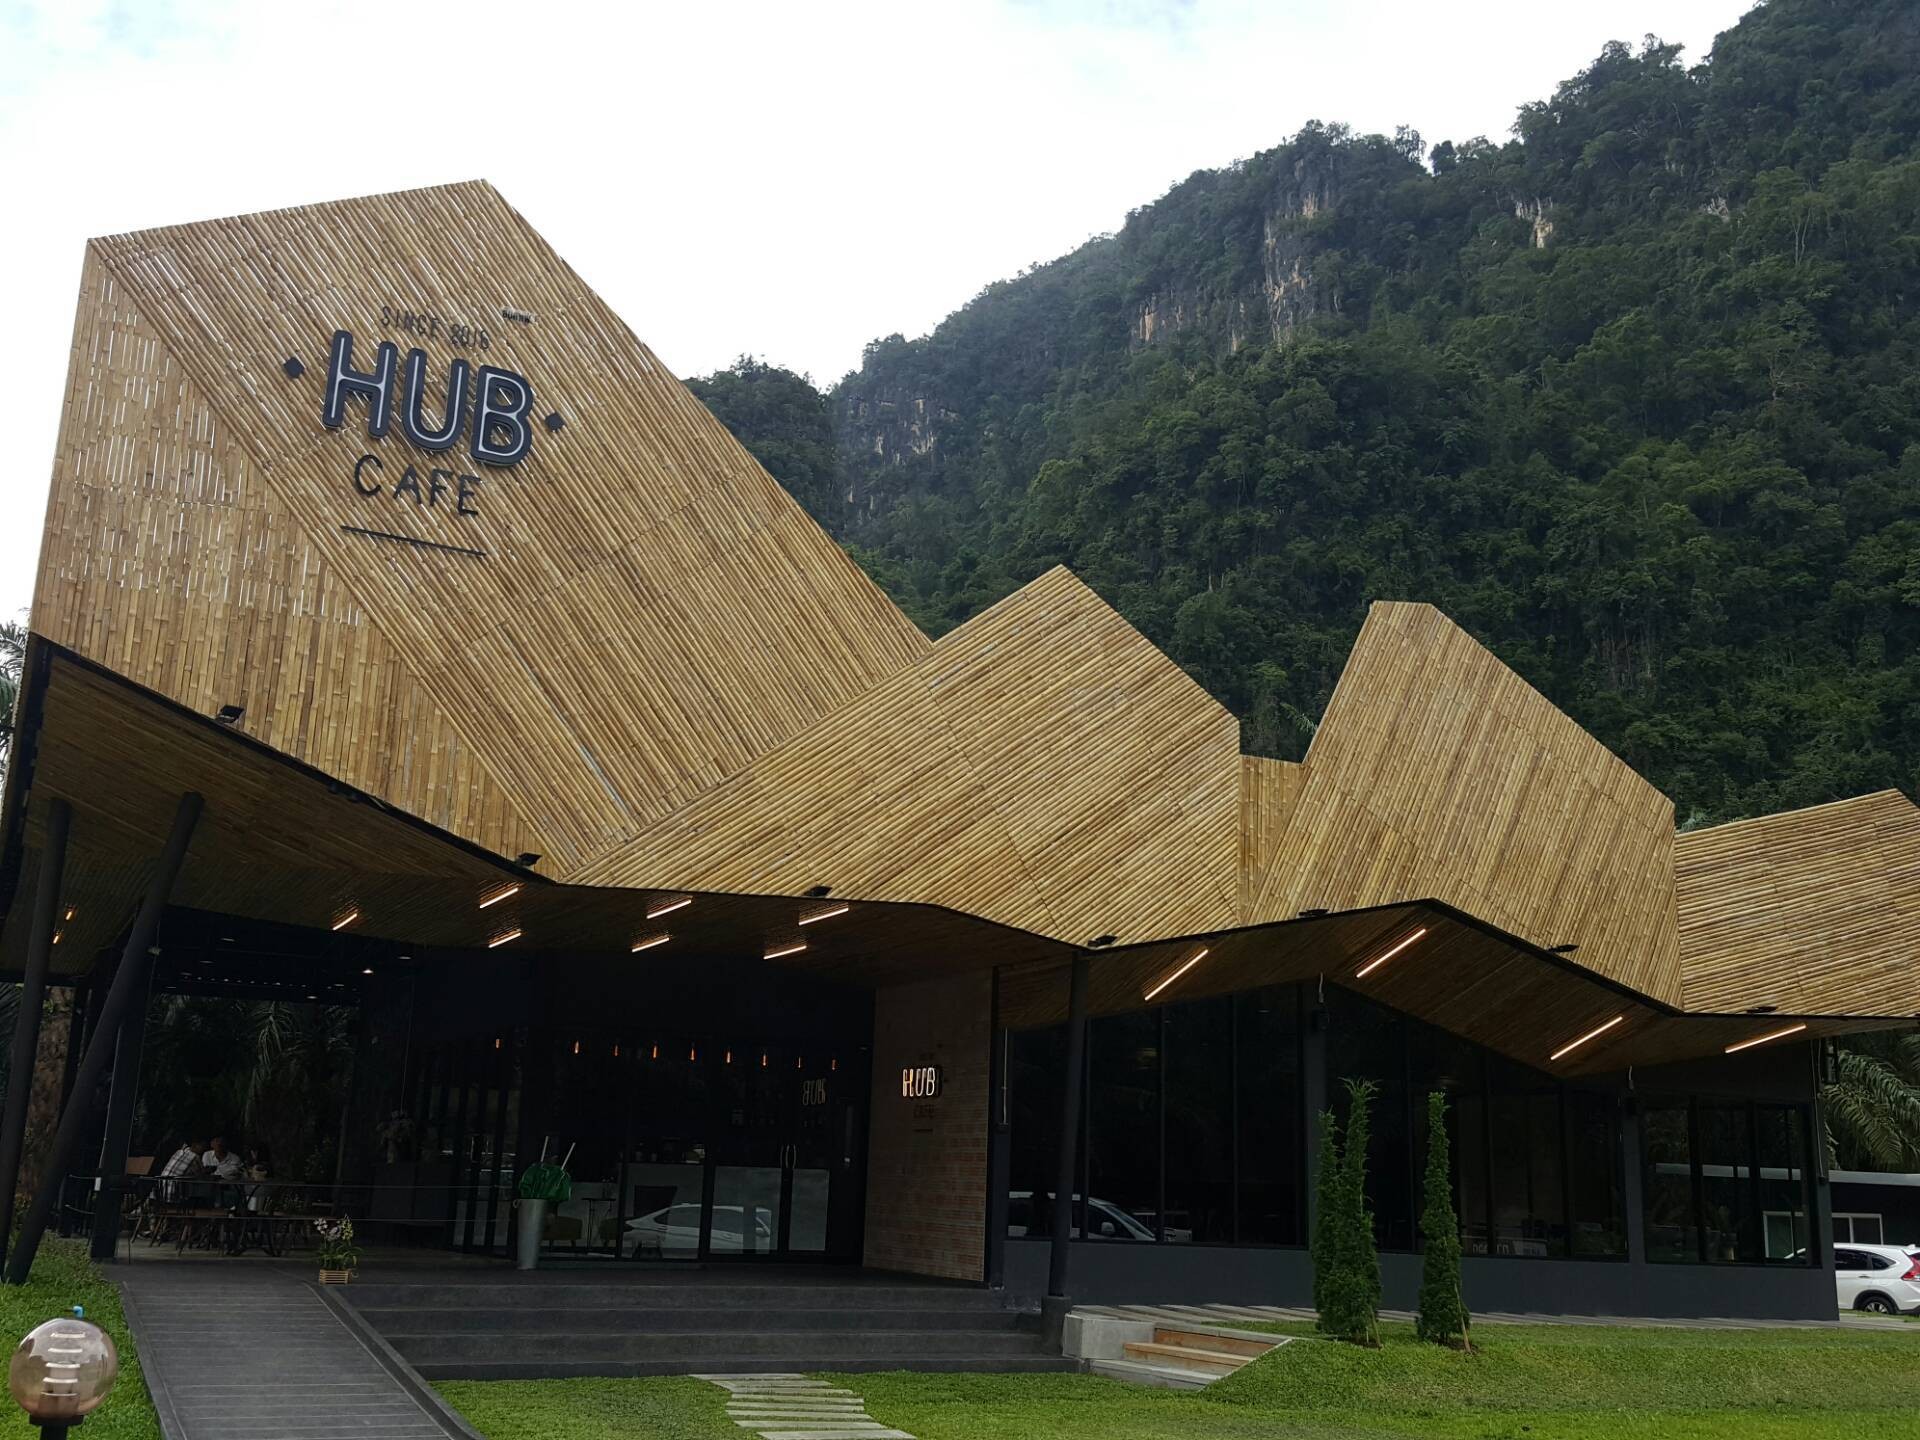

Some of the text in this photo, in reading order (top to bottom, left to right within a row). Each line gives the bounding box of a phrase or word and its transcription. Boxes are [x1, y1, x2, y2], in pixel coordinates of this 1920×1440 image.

[380, 306, 440, 338] SINCE
[321, 329, 534, 467] HUB
[354, 454, 481, 516] CAFE
[902, 1067, 937, 1097] HUB
